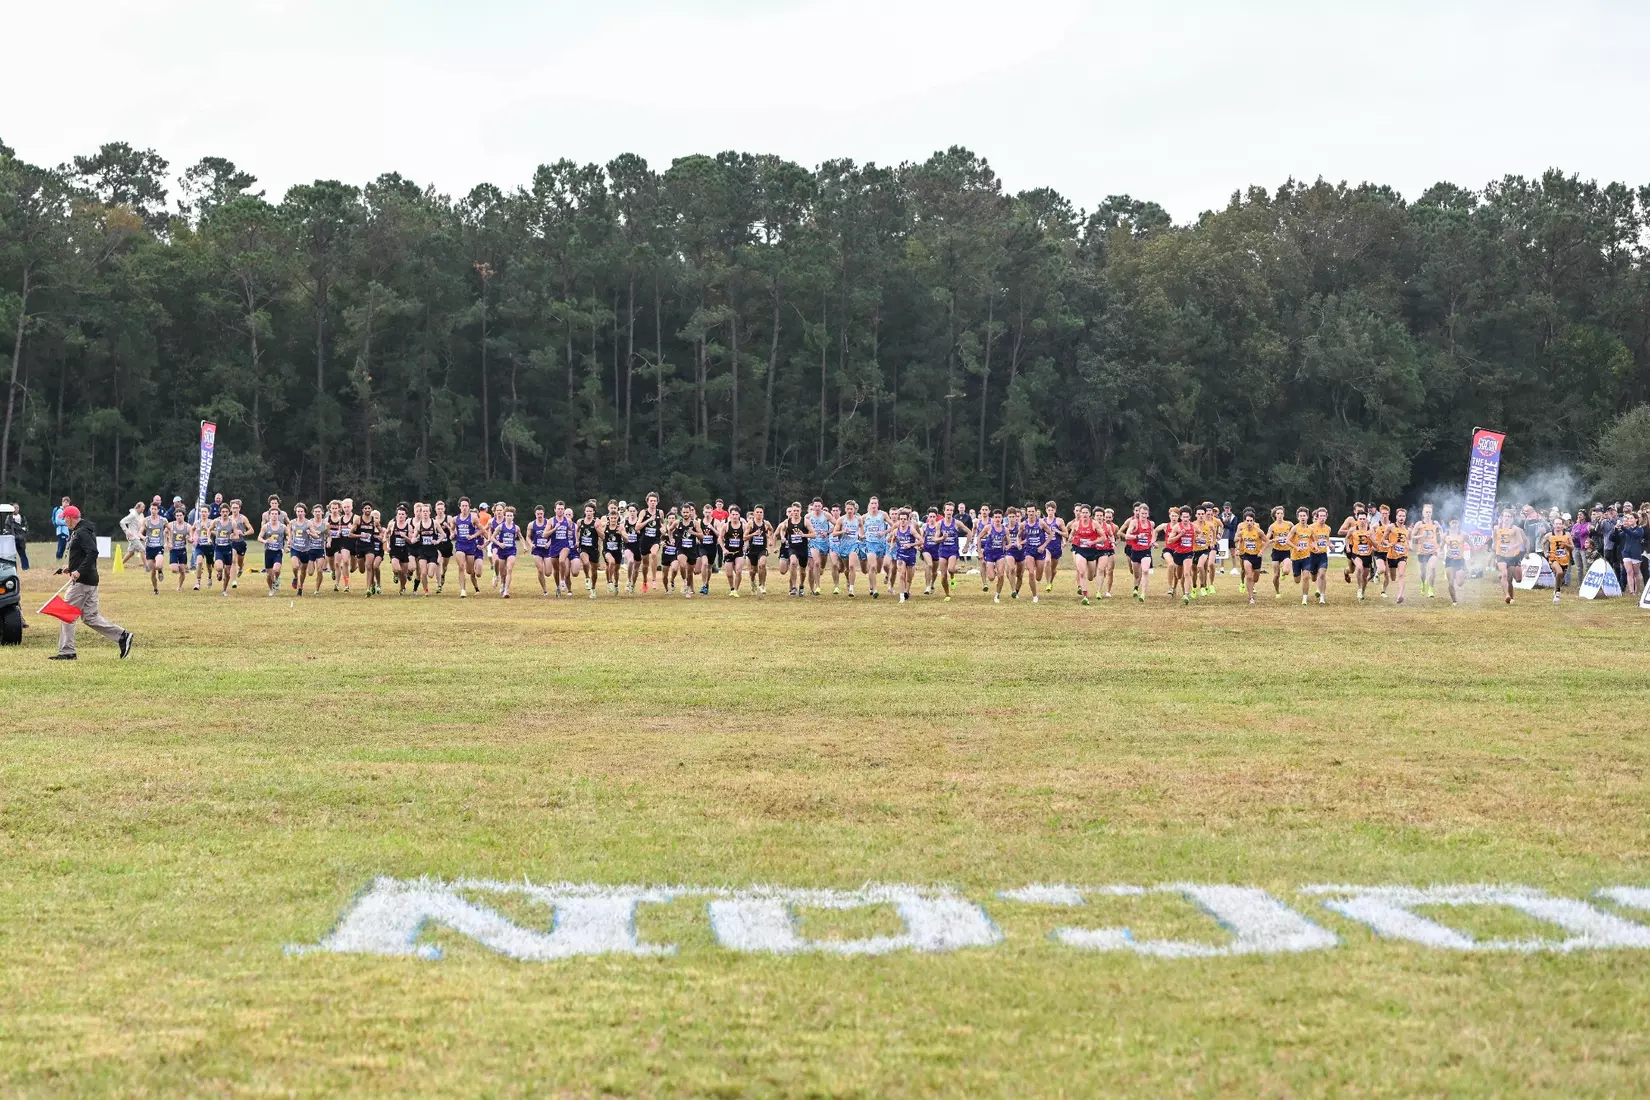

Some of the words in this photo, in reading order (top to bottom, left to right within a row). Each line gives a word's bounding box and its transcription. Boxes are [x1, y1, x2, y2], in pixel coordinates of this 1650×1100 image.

[1472, 457, 1484, 467] THE
[1464, 465, 1484, 526] SOUTHERN
[1477, 459, 1498, 531] CONFERENCE
